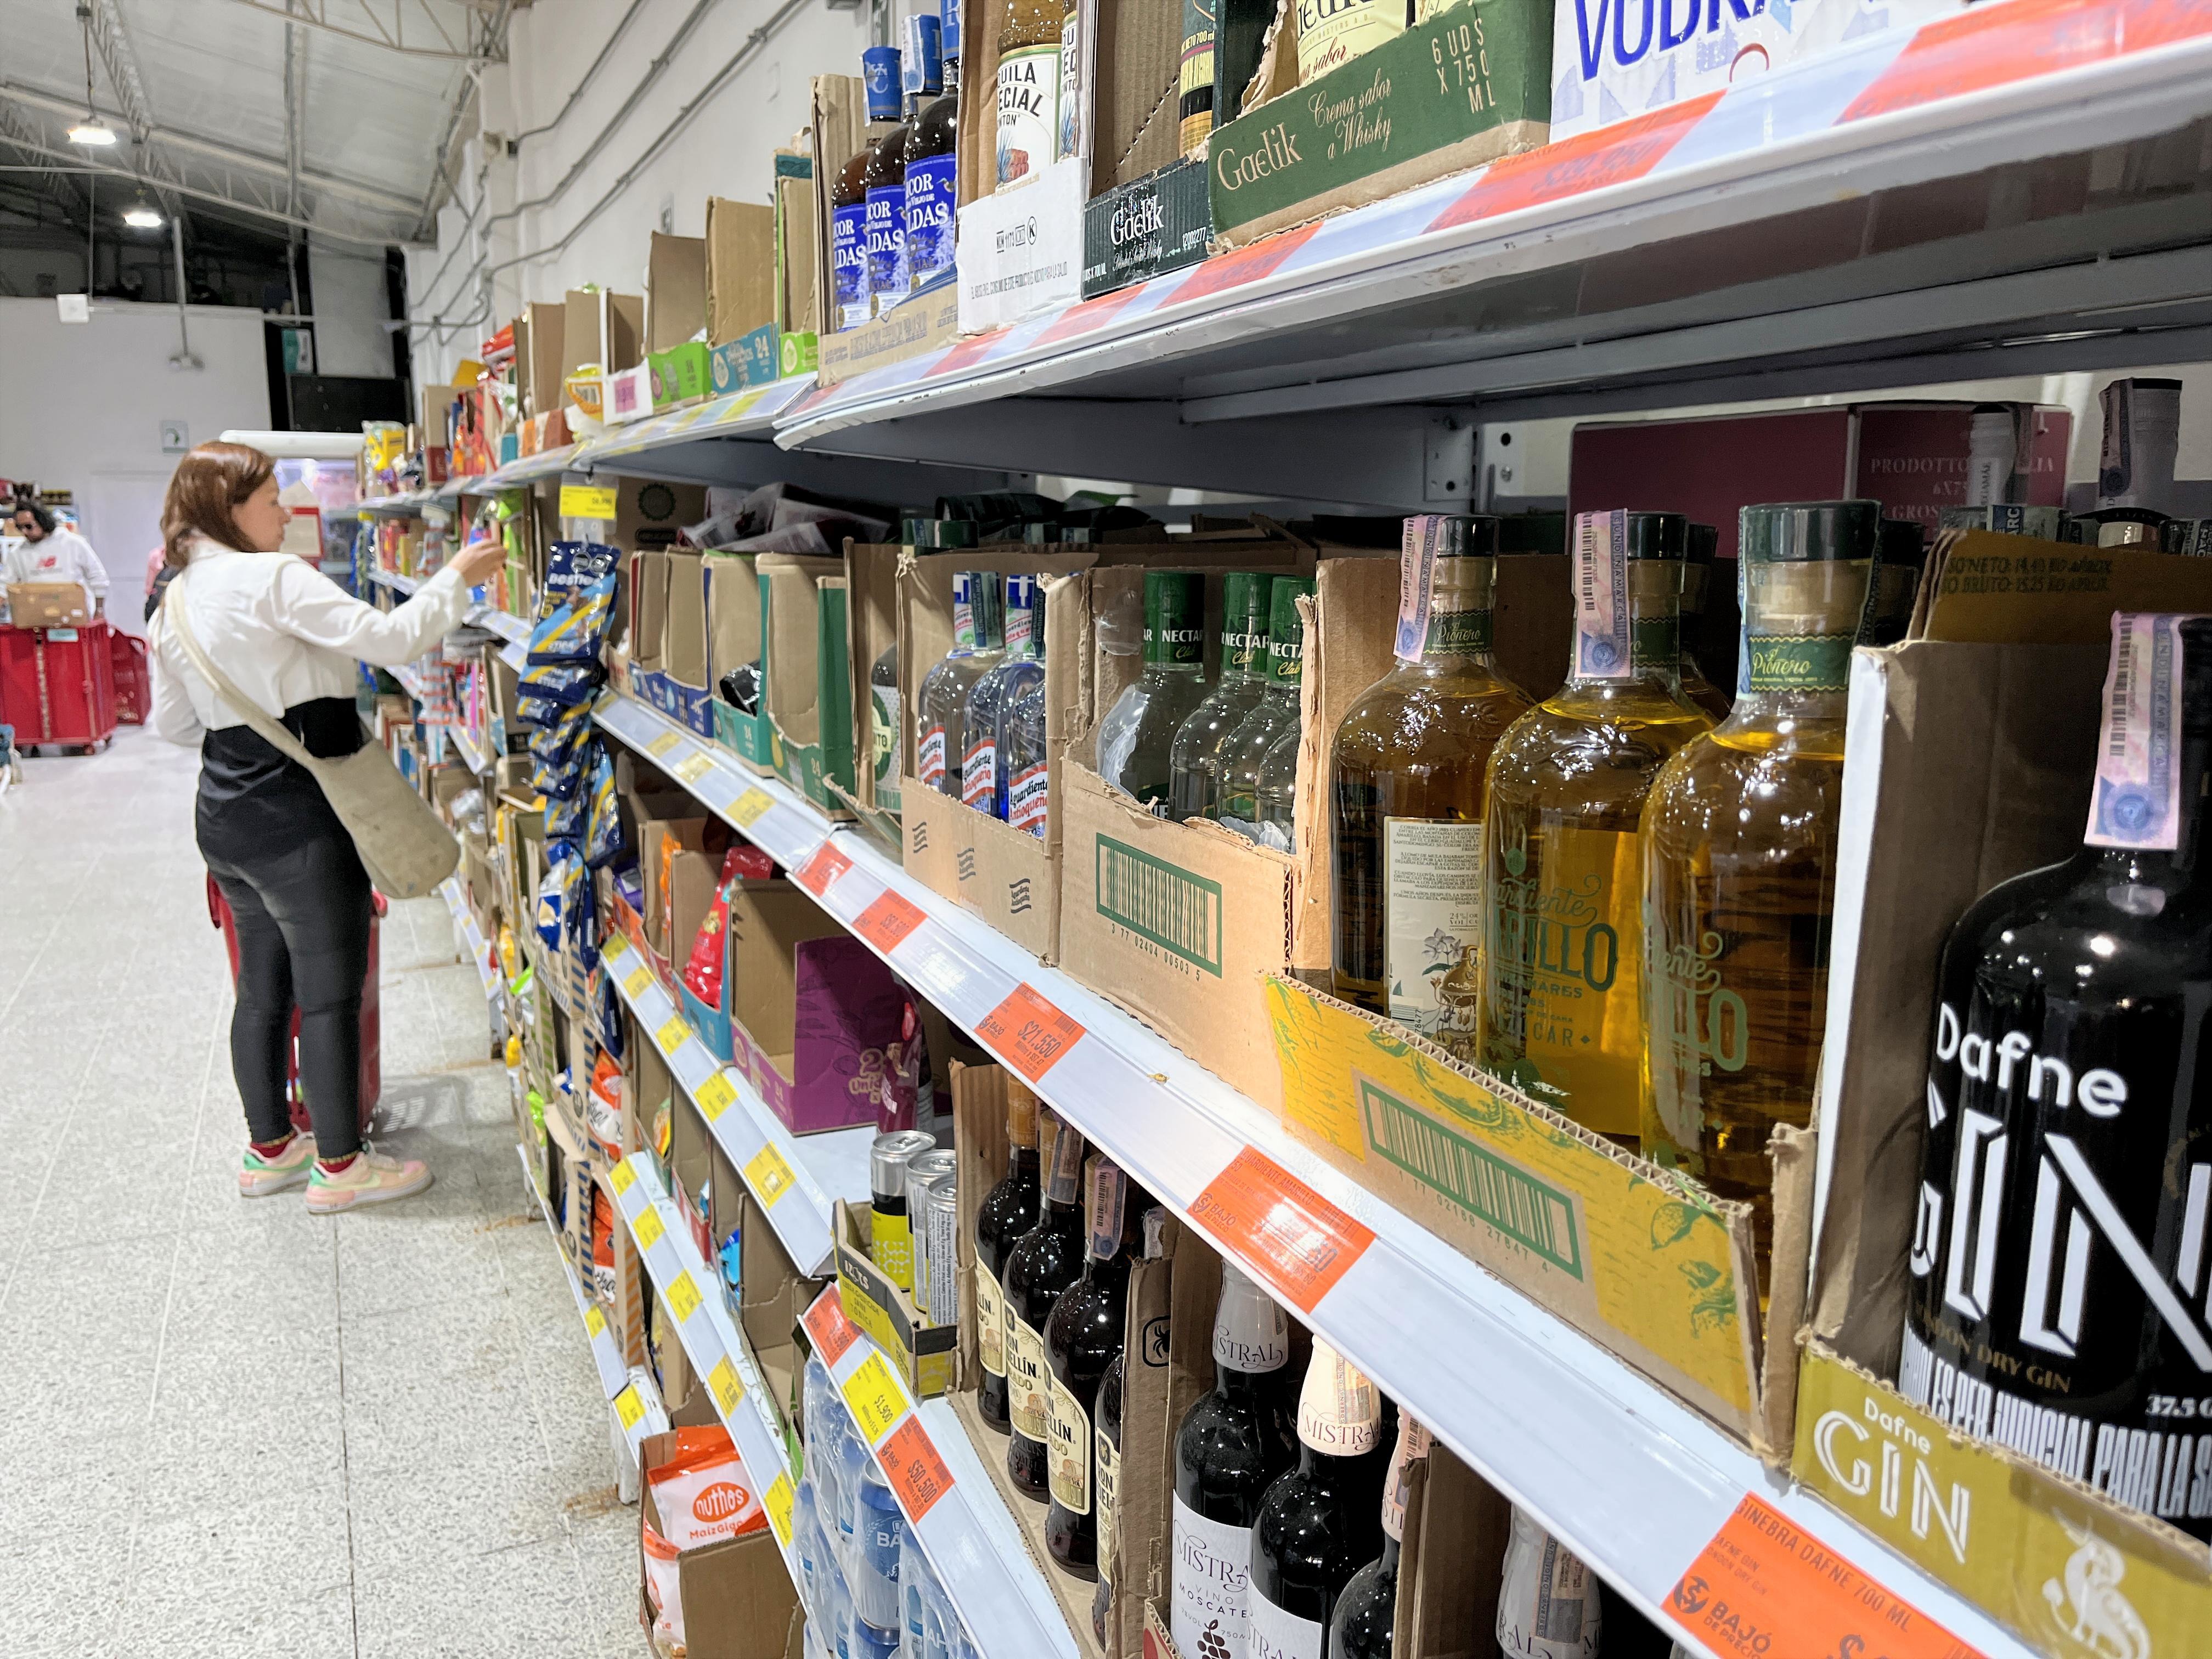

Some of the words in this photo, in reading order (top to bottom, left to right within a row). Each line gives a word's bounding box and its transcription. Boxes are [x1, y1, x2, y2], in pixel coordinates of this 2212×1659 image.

[1313, 37, 1347, 74] sabor
[1431, 38, 1443, 66] 6
[1448, 18, 1485, 58] UDS
[1436, 67, 1449, 95] X
[1453, 49, 1490, 87] 750
[1308, 91, 1355, 128] Crema
[1358, 67, 1392, 109] sabor
[1467, 81, 1496, 114] ML
[1328, 143, 1335, 160] a
[1335, 108, 1392, 154] Whisky
[1217, 122, 1303, 191] Gaelik
[1029, 224, 1035, 238] K
[1110, 195, 1164, 246] Gaelik
[754, 336, 770, 358] 24
[1614, 516, 1623, 622] CUNDINAMARCA
[1176, 643, 1195, 659] Club
[1224, 633, 1269, 650] NECTAR
[1232, 650, 1254, 665] Club
[1278, 661, 1302, 675] Club
[1752, 652, 1811, 676] Pionero
[743, 724, 754, 742] 24
[810, 757, 822, 777] 24
[1111, 923, 1116, 934] 3
[1121, 927, 1129, 941] 77
[1135, 936, 1158, 958] 02404
[1164, 951, 1190, 976] 00503
[1196, 969, 1200, 982] 5
[990, 1020, 1006, 1035] BAJÓ
[1018, 1020, 1062, 1058] $21.550
[1937, 1001, 2129, 1118] Dafne
[1279, 1177, 1315, 1206] AMARILLO
[1210, 1203, 1238, 1226] BAJÓ
[1210, 1215, 1229, 1233] PRECIO
[1414, 1178, 1426, 1194] 77
[1542, 1261, 1549, 1273] 4
[1977, 1346, 2022, 1377] DRY
[2026, 1365, 2071, 1394] GIN
[2146, 1394, 2196, 1418] 37.5
[1865, 1396, 1931, 1455] Dafne
[908, 1459, 937, 1503] $50.500
[1813, 1410, 1971, 1565] GIN
[2091, 1423, 2163, 1517] PARA
[696, 1485, 744, 1517] nuthos
[1736, 1498, 1796, 1551] GINEBRA
[1799, 1543, 1854, 1590] DAFNE
[1853, 1582, 1886, 1612] 700
[1886, 1604, 1914, 1633] ML
[1195, 1584, 1234, 1605] VINO
[1703, 1616, 1720, 1633] DE
[1711, 1601, 1772, 1655] BAJÓ
